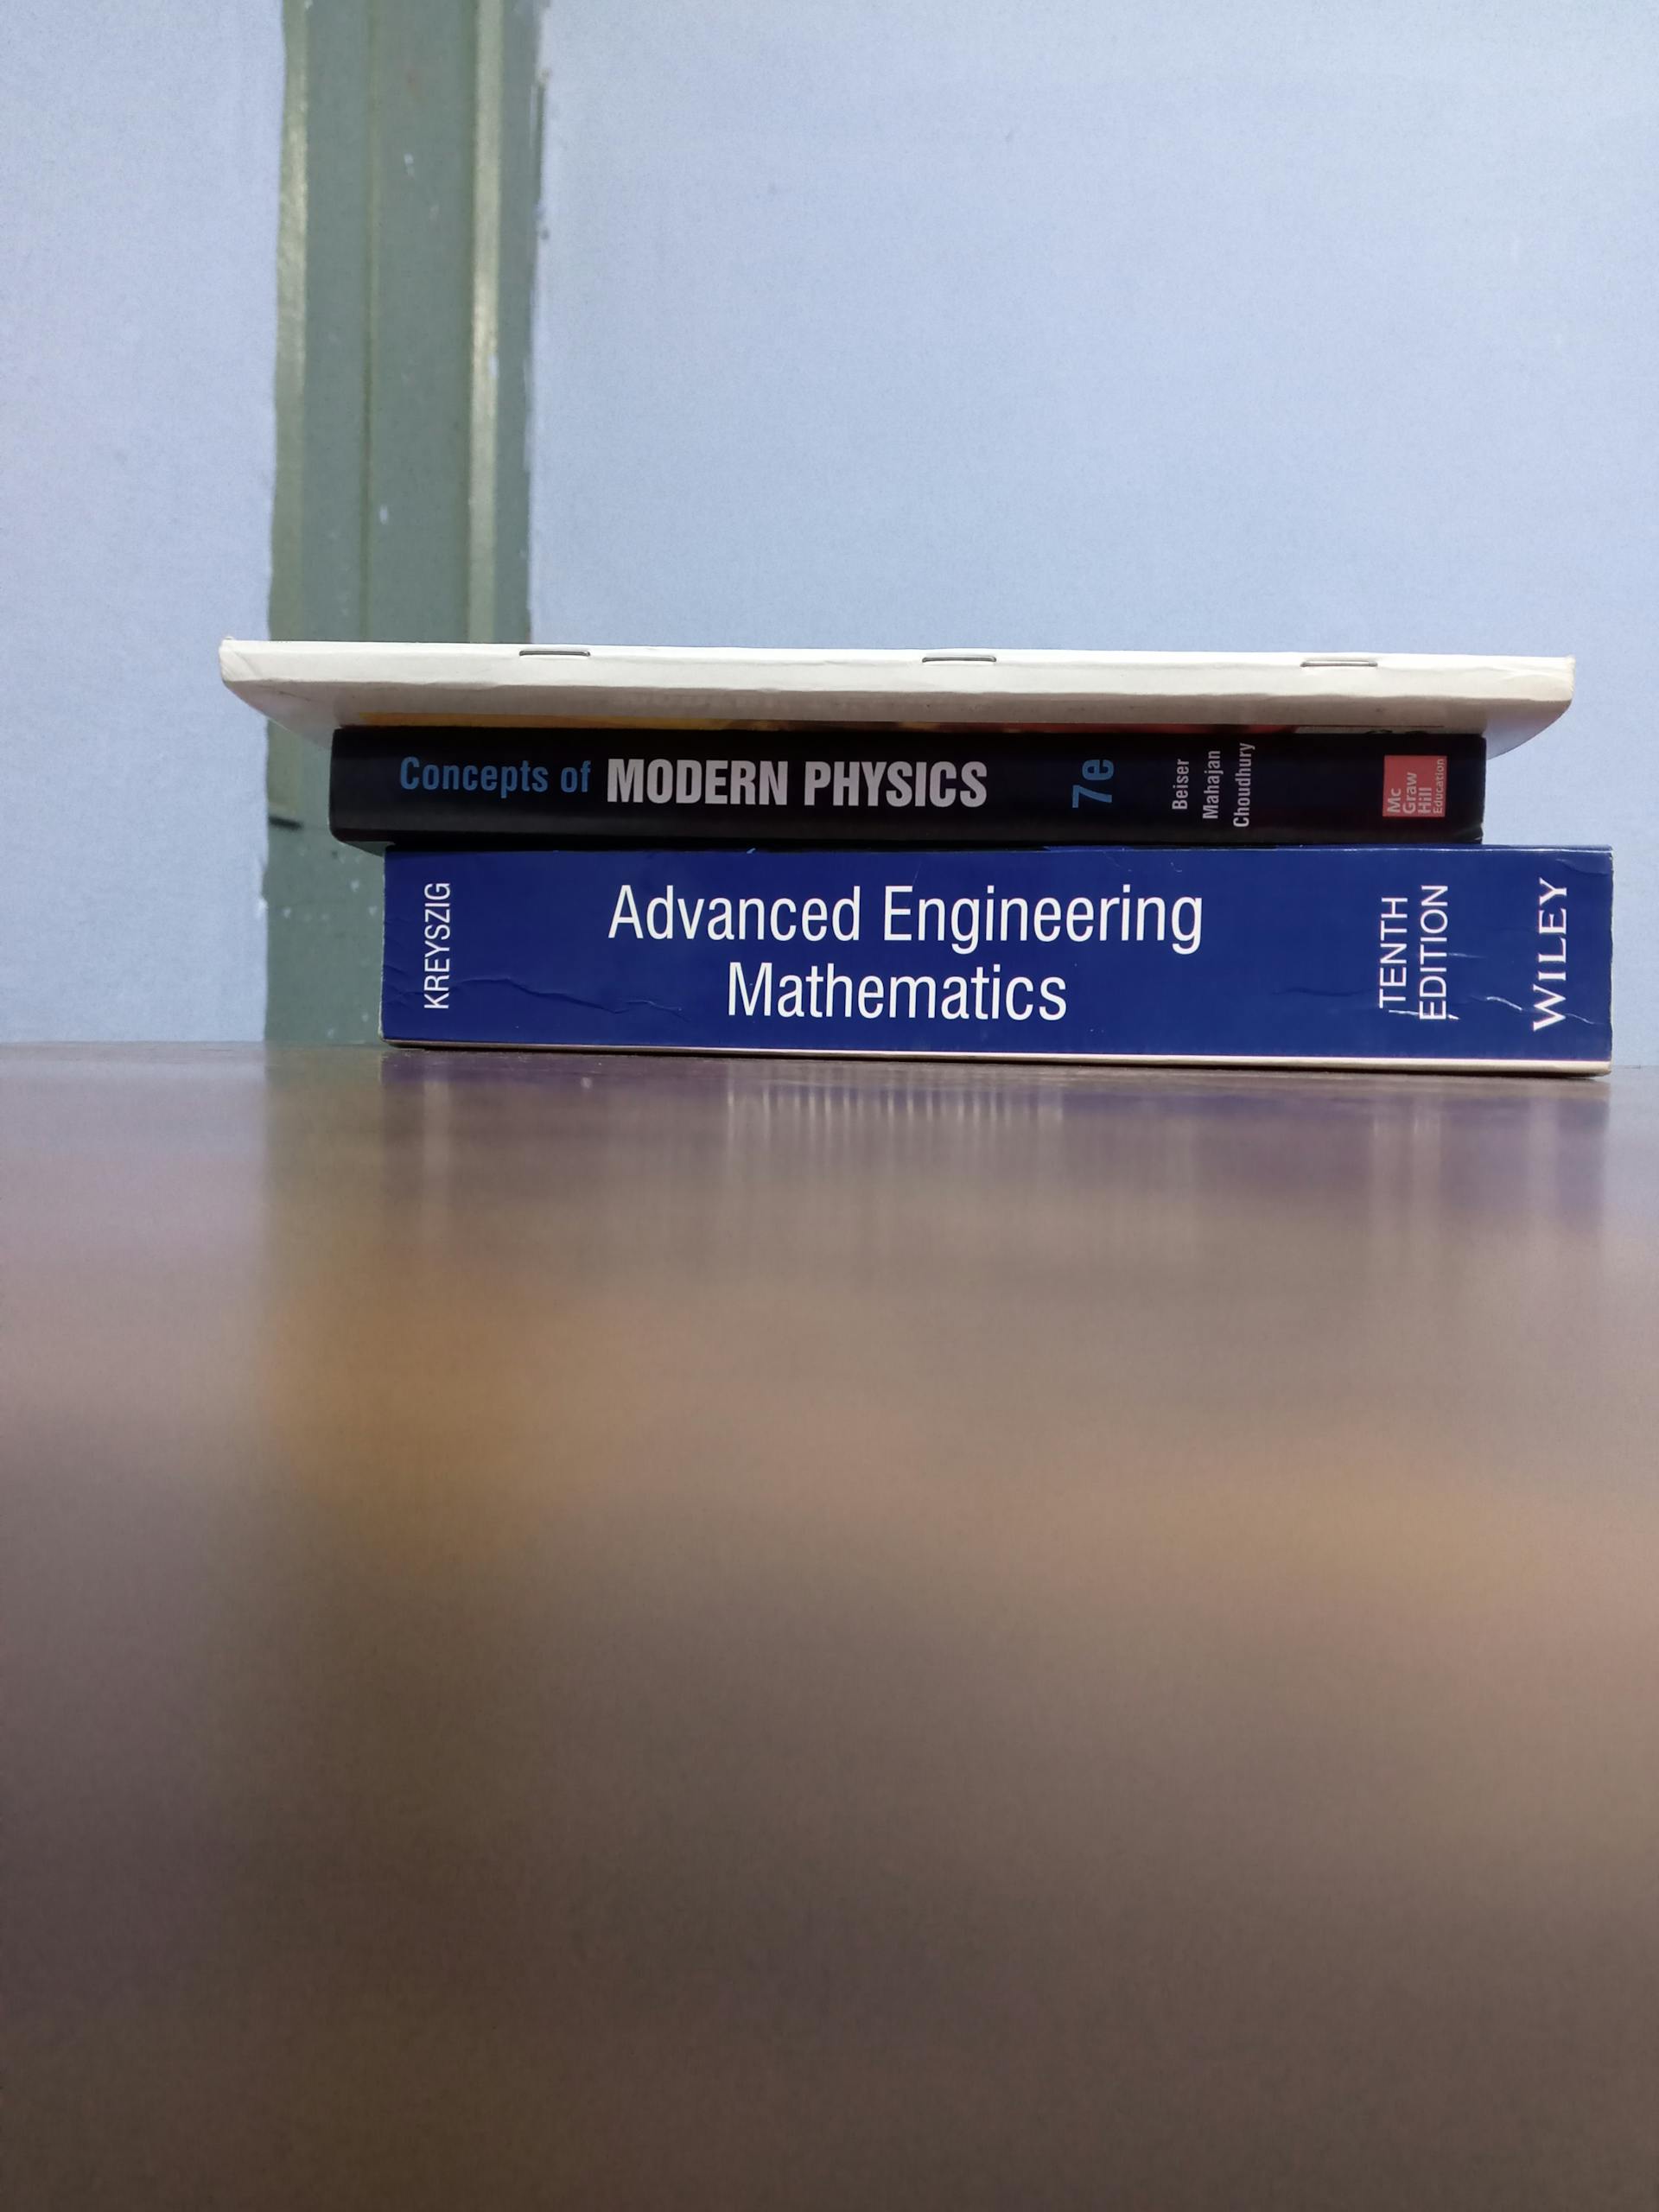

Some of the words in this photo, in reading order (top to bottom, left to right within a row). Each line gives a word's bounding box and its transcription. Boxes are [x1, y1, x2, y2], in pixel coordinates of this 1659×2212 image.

[399, 756, 548, 798] Concepts
[560, 760, 591, 793] of
[607, 758, 788, 806] MODERN
[804, 760, 988, 808] PHYSICS
[1071, 758, 1115, 809] 7e
[1172, 759, 1190, 810] Beiser
[1202, 750, 1224, 820] Mahajan
[1233, 742, 1255, 828] Choudhury
[1387, 787, 1402, 813] Mc
[1402, 772, 1417, 814] Graw
[1417, 787, 1432, 814] Hill
[1433, 759, 1446, 814] Education
[423, 882, 450, 1009] KREYSZIG
[607, 884, 861, 942] Advanced
[883, 884, 1204, 957] Engineering
[1378, 897, 1408, 1009] TENTH
[1418, 884, 1449, 1020] EDITION
[1532, 877, 1568, 1032] WILEY
[728, 961, 1068, 1021] Mathematics
